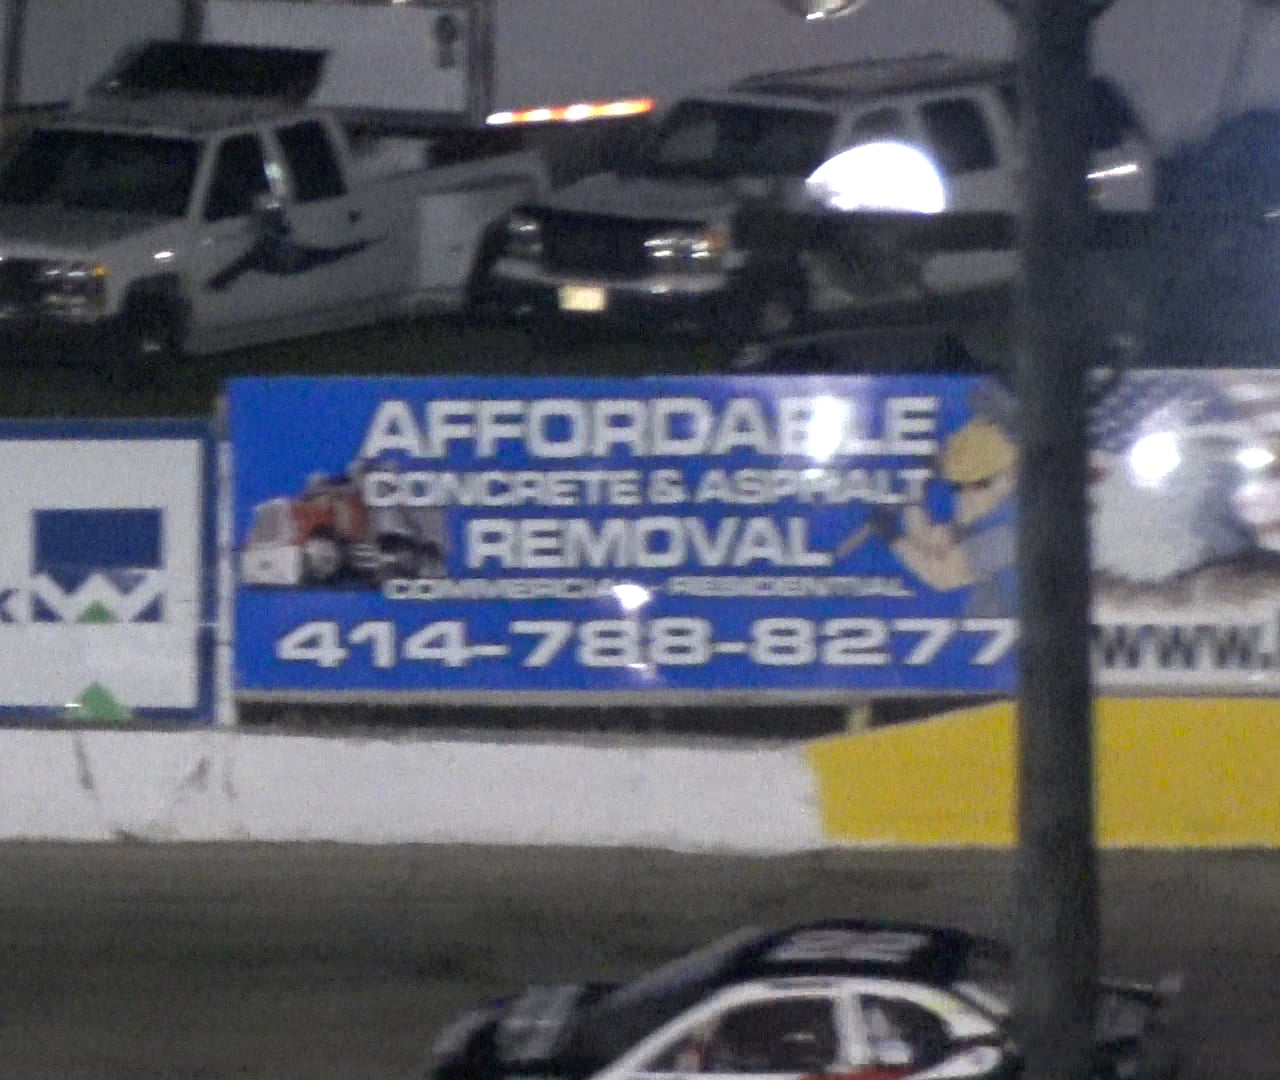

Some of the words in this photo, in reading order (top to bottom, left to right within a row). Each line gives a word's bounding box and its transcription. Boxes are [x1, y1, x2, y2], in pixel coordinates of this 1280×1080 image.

[360, 469, 642, 507] CONCRETE
[647, 468, 688, 505] &
[692, 468, 936, 505] ASPHALT
[465, 515, 834, 570] REMOVAL
[276, 618, 1022, 669] 414-788-8277
